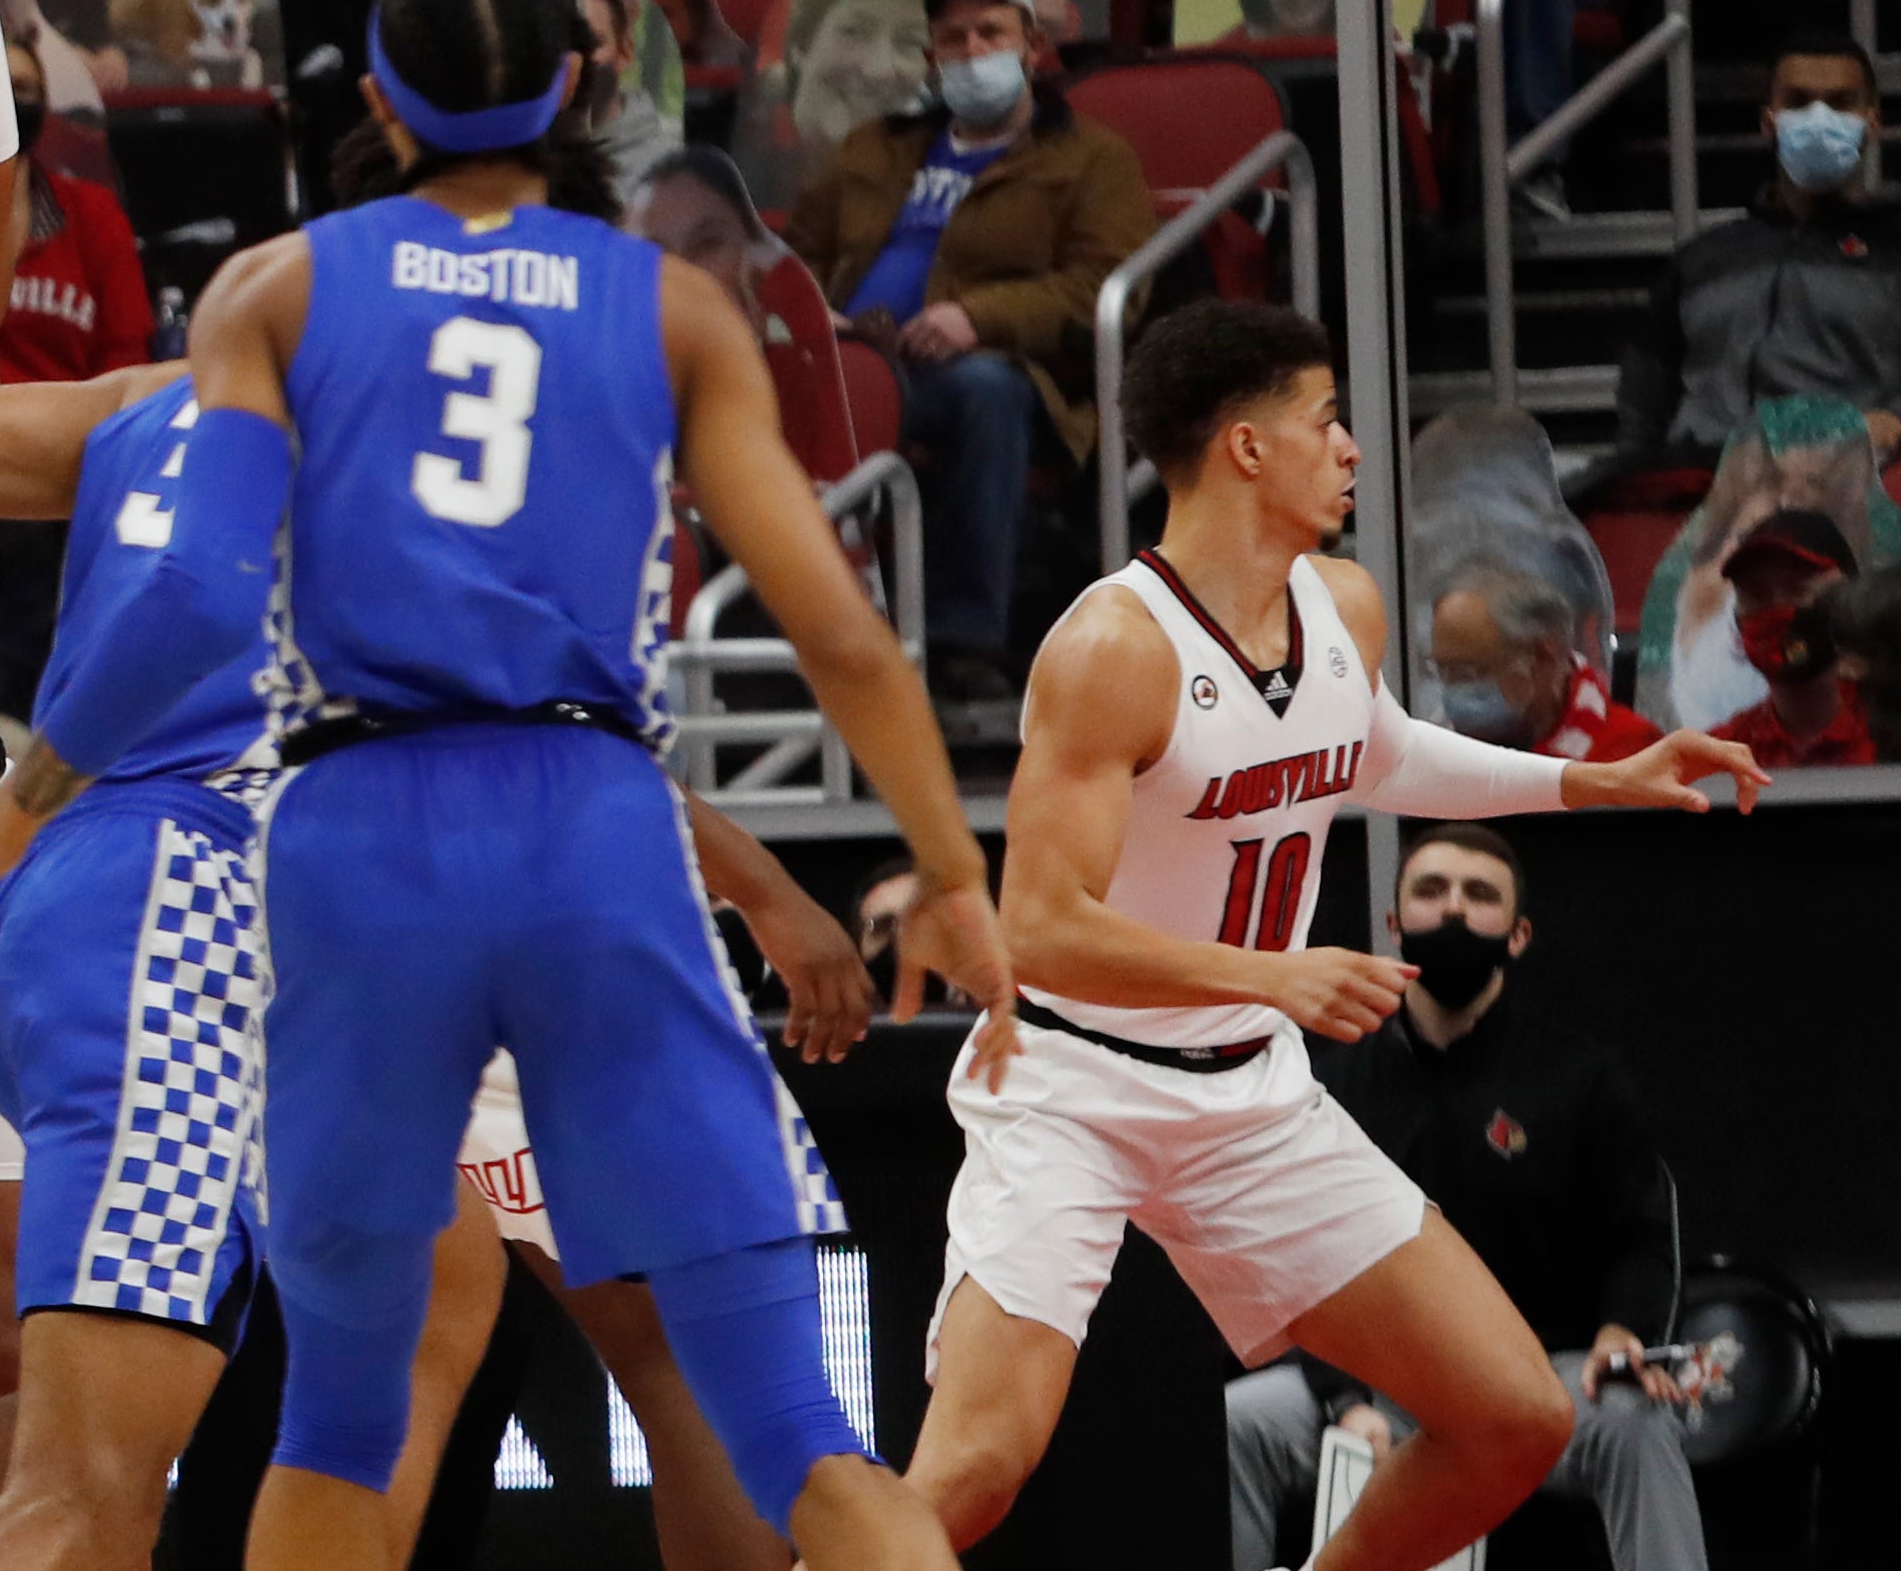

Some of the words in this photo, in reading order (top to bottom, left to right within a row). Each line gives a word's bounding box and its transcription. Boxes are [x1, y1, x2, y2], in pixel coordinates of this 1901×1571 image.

[392, 239, 580, 312] BOSTON
[410, 315, 543, 528] 3
[1216, 831, 1312, 953] 10
